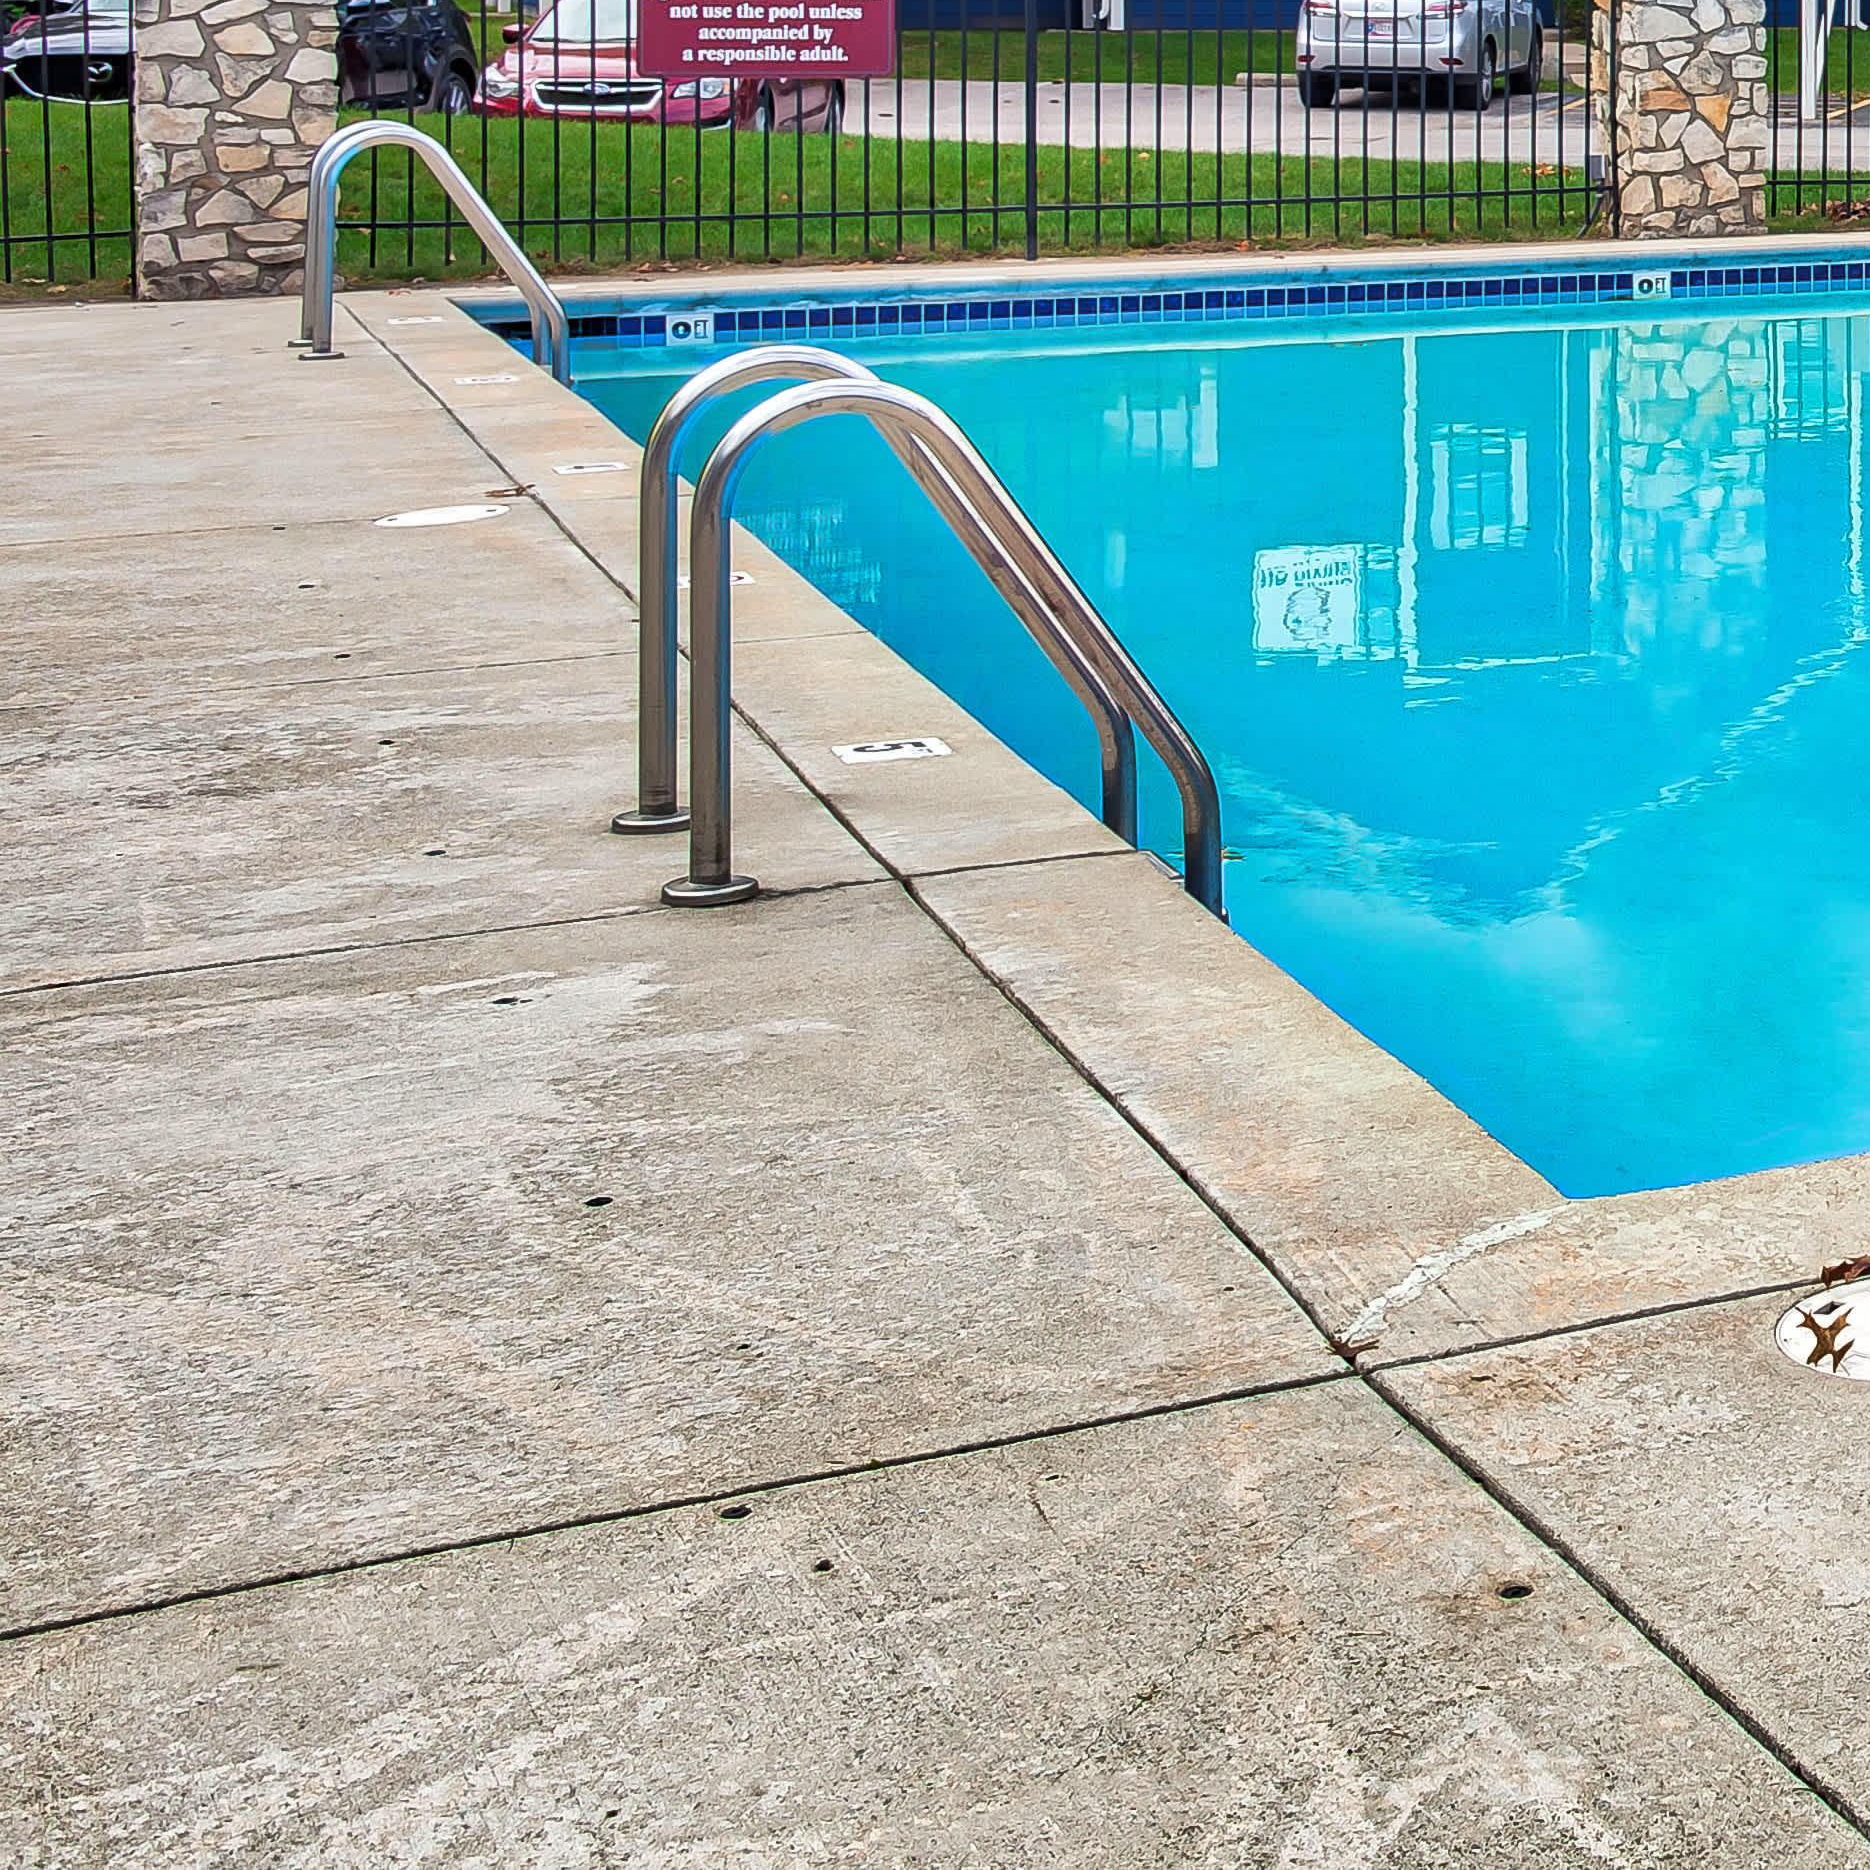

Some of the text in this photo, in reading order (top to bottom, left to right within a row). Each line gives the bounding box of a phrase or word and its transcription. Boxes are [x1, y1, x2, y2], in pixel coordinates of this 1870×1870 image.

[669, 2, 863, 23] not use the pool unless
[698, 24, 834, 44] accompanied by
[682, 45, 849, 65] a responsible adult.
